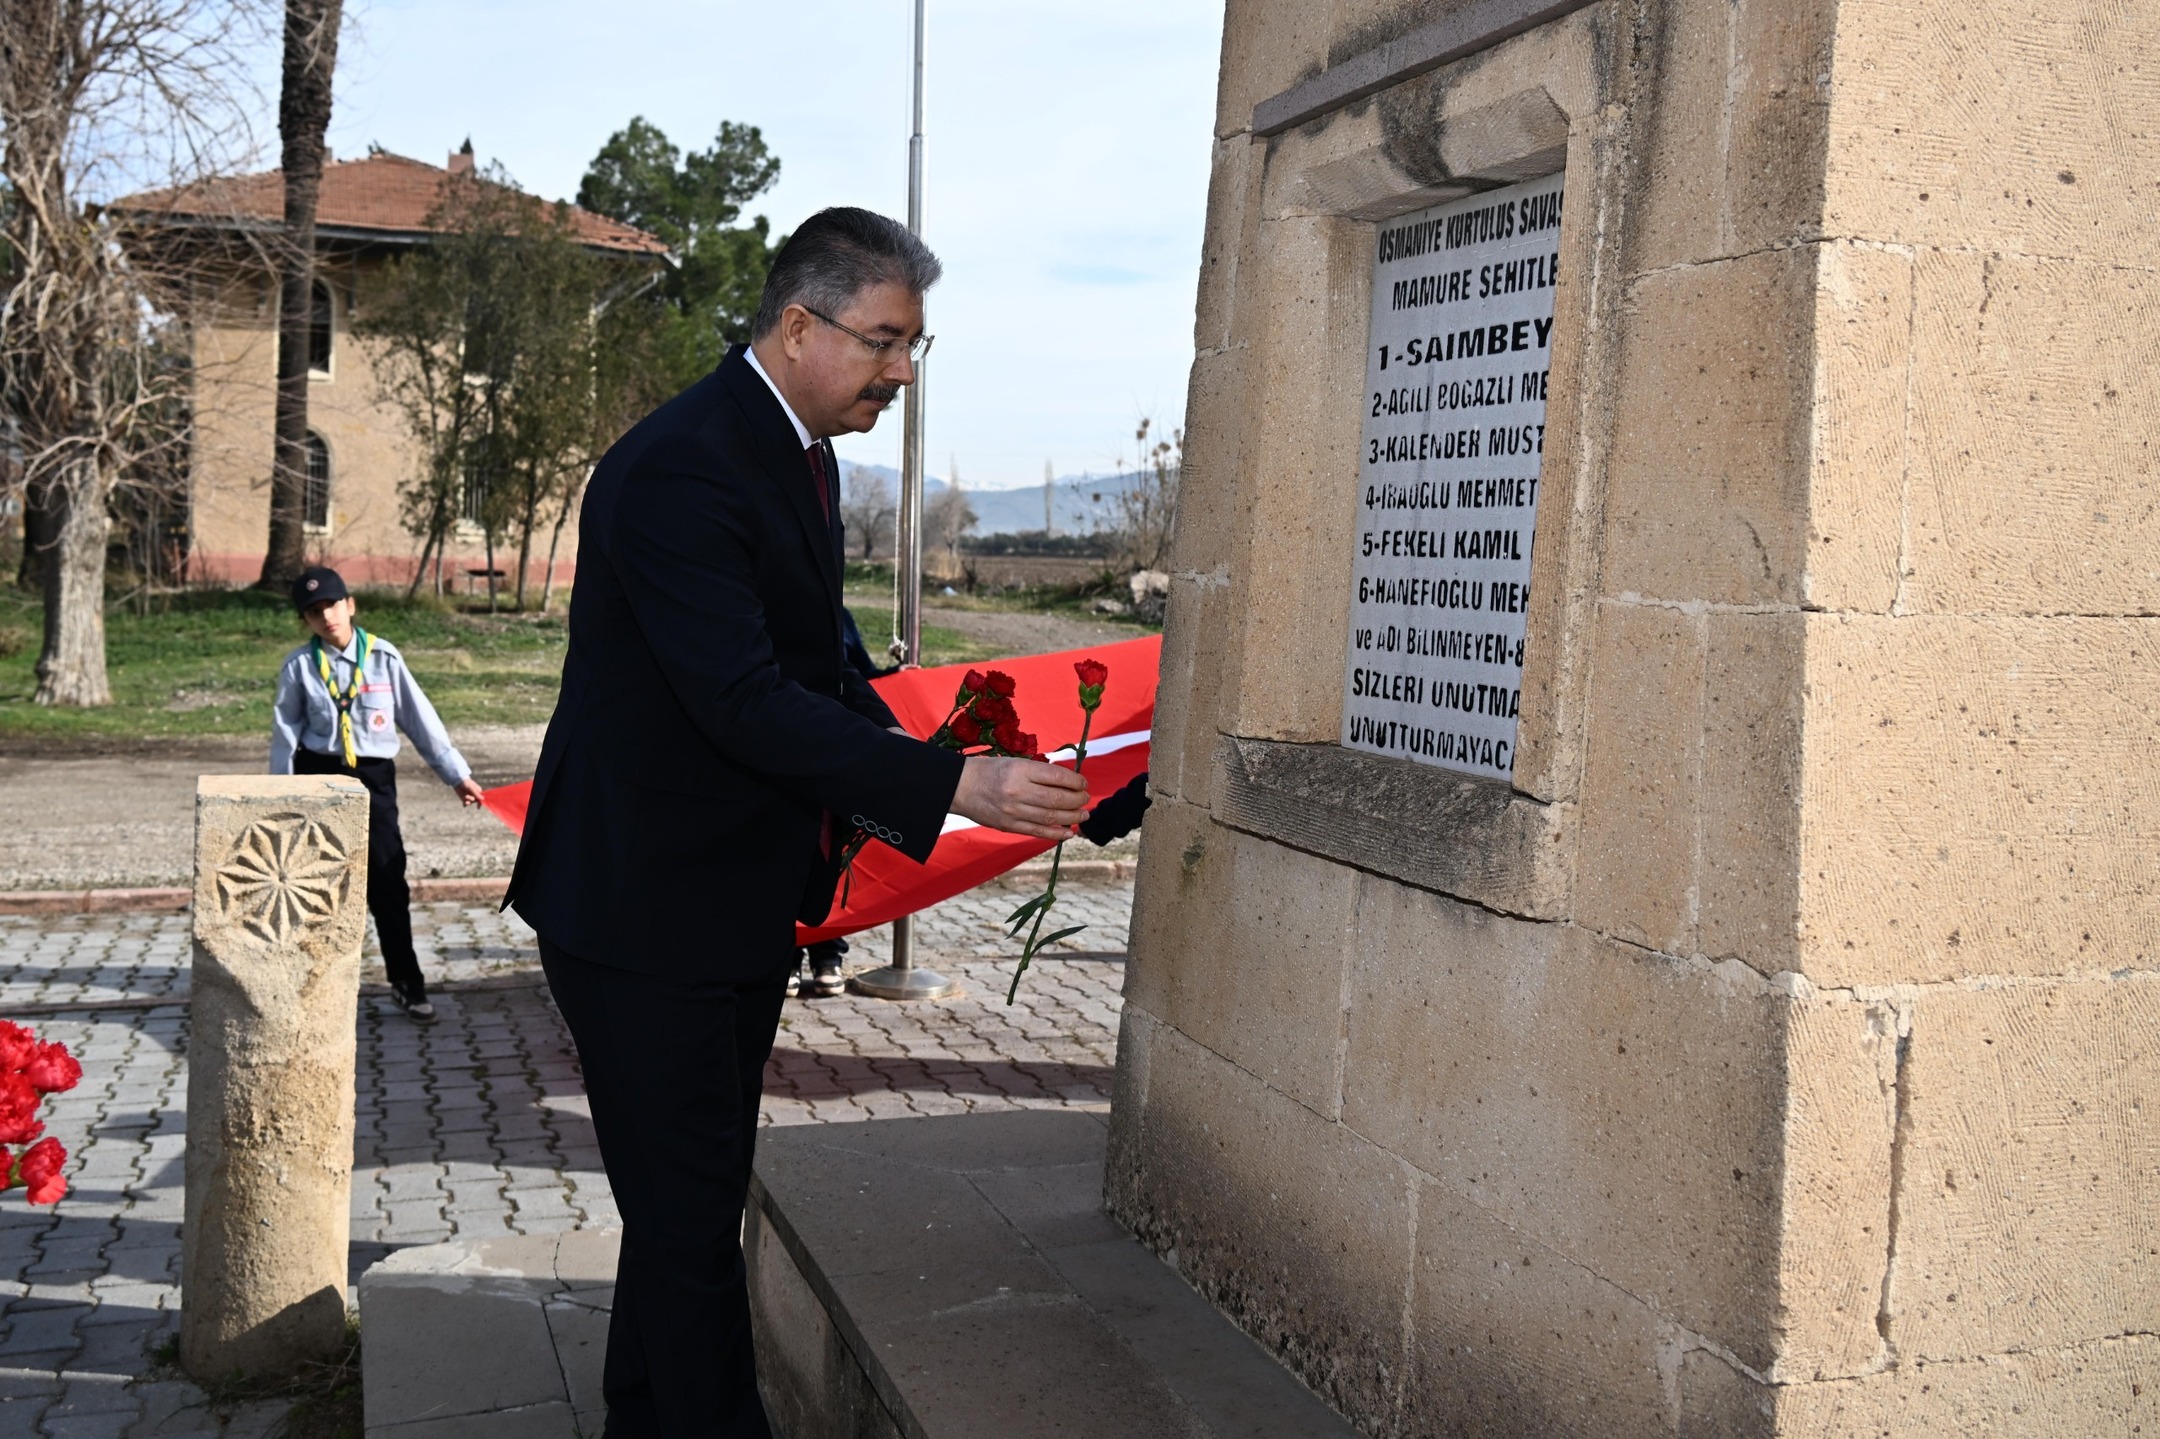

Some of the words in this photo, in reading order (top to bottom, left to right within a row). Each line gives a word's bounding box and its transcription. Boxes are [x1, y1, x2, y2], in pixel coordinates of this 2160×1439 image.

[1446, 201, 1515, 250] KURTULUS
[1392, 269, 1472, 311] MAMURE
[1521, 370, 1549, 402] ME
[1368, 429, 1480, 464] 3-KALENDER
[1488, 425, 1545, 456] MUST
[1457, 478, 1538, 508] MEHMET
[1362, 530, 1445, 557] 5-FEKELI
[1453, 530, 1521, 560] KAMIL
[1356, 628, 1372, 650] ve
[1431, 680, 1521, 718] UNUTMA
[1350, 715, 1516, 772] UNUTTURMAYAC
